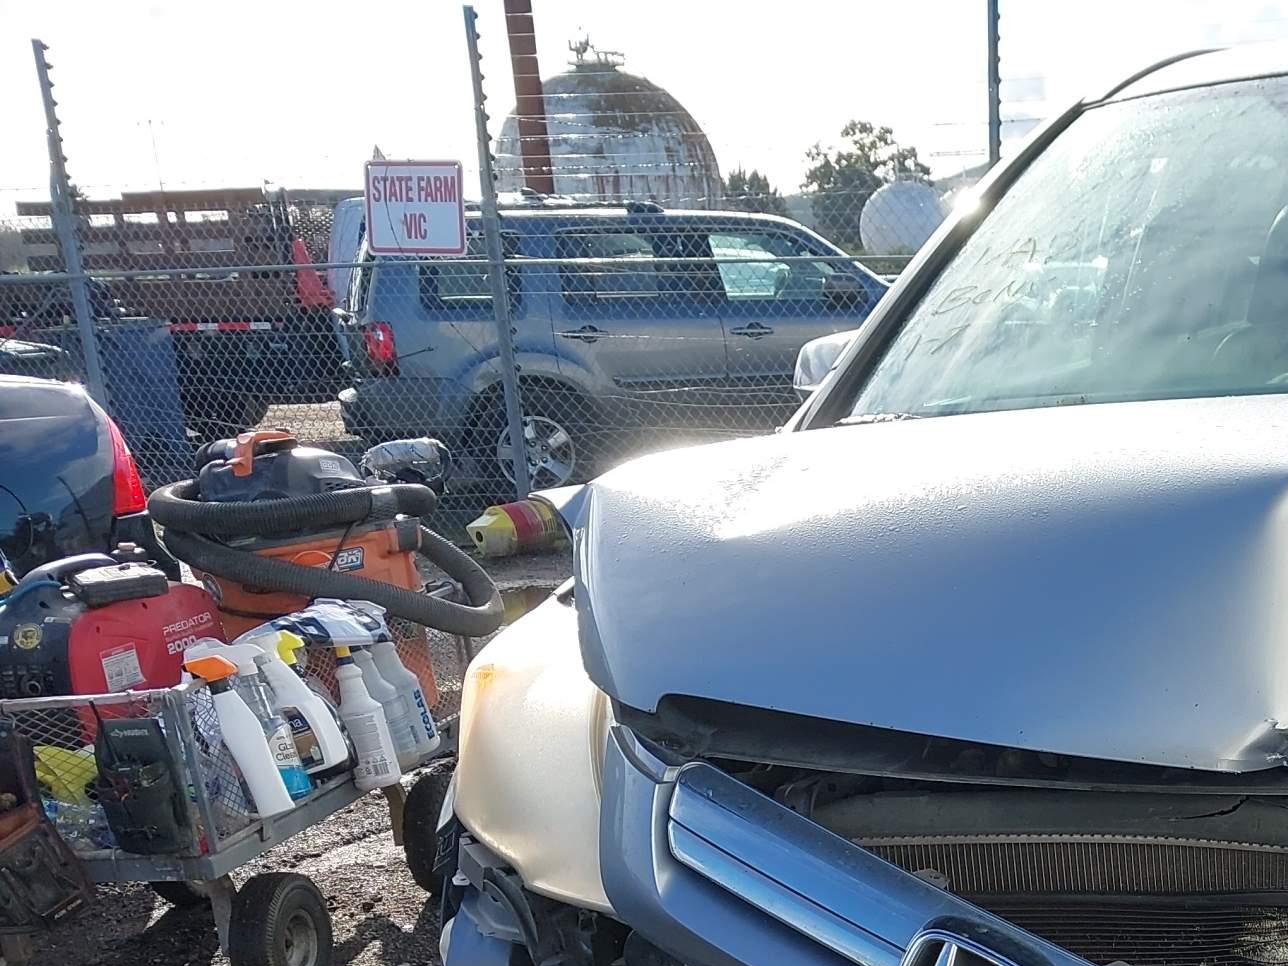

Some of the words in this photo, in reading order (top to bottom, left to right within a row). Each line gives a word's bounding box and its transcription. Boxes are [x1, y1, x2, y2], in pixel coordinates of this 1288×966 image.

[372, 175, 414, 203] STATE
[417, 175, 457, 203] FARM
[403, 212, 428, 240] VIC
[162, 611, 212, 636] PREDATOR
[167, 635, 198, 655] 2000
[413, 689, 436, 740] ECOLAB
